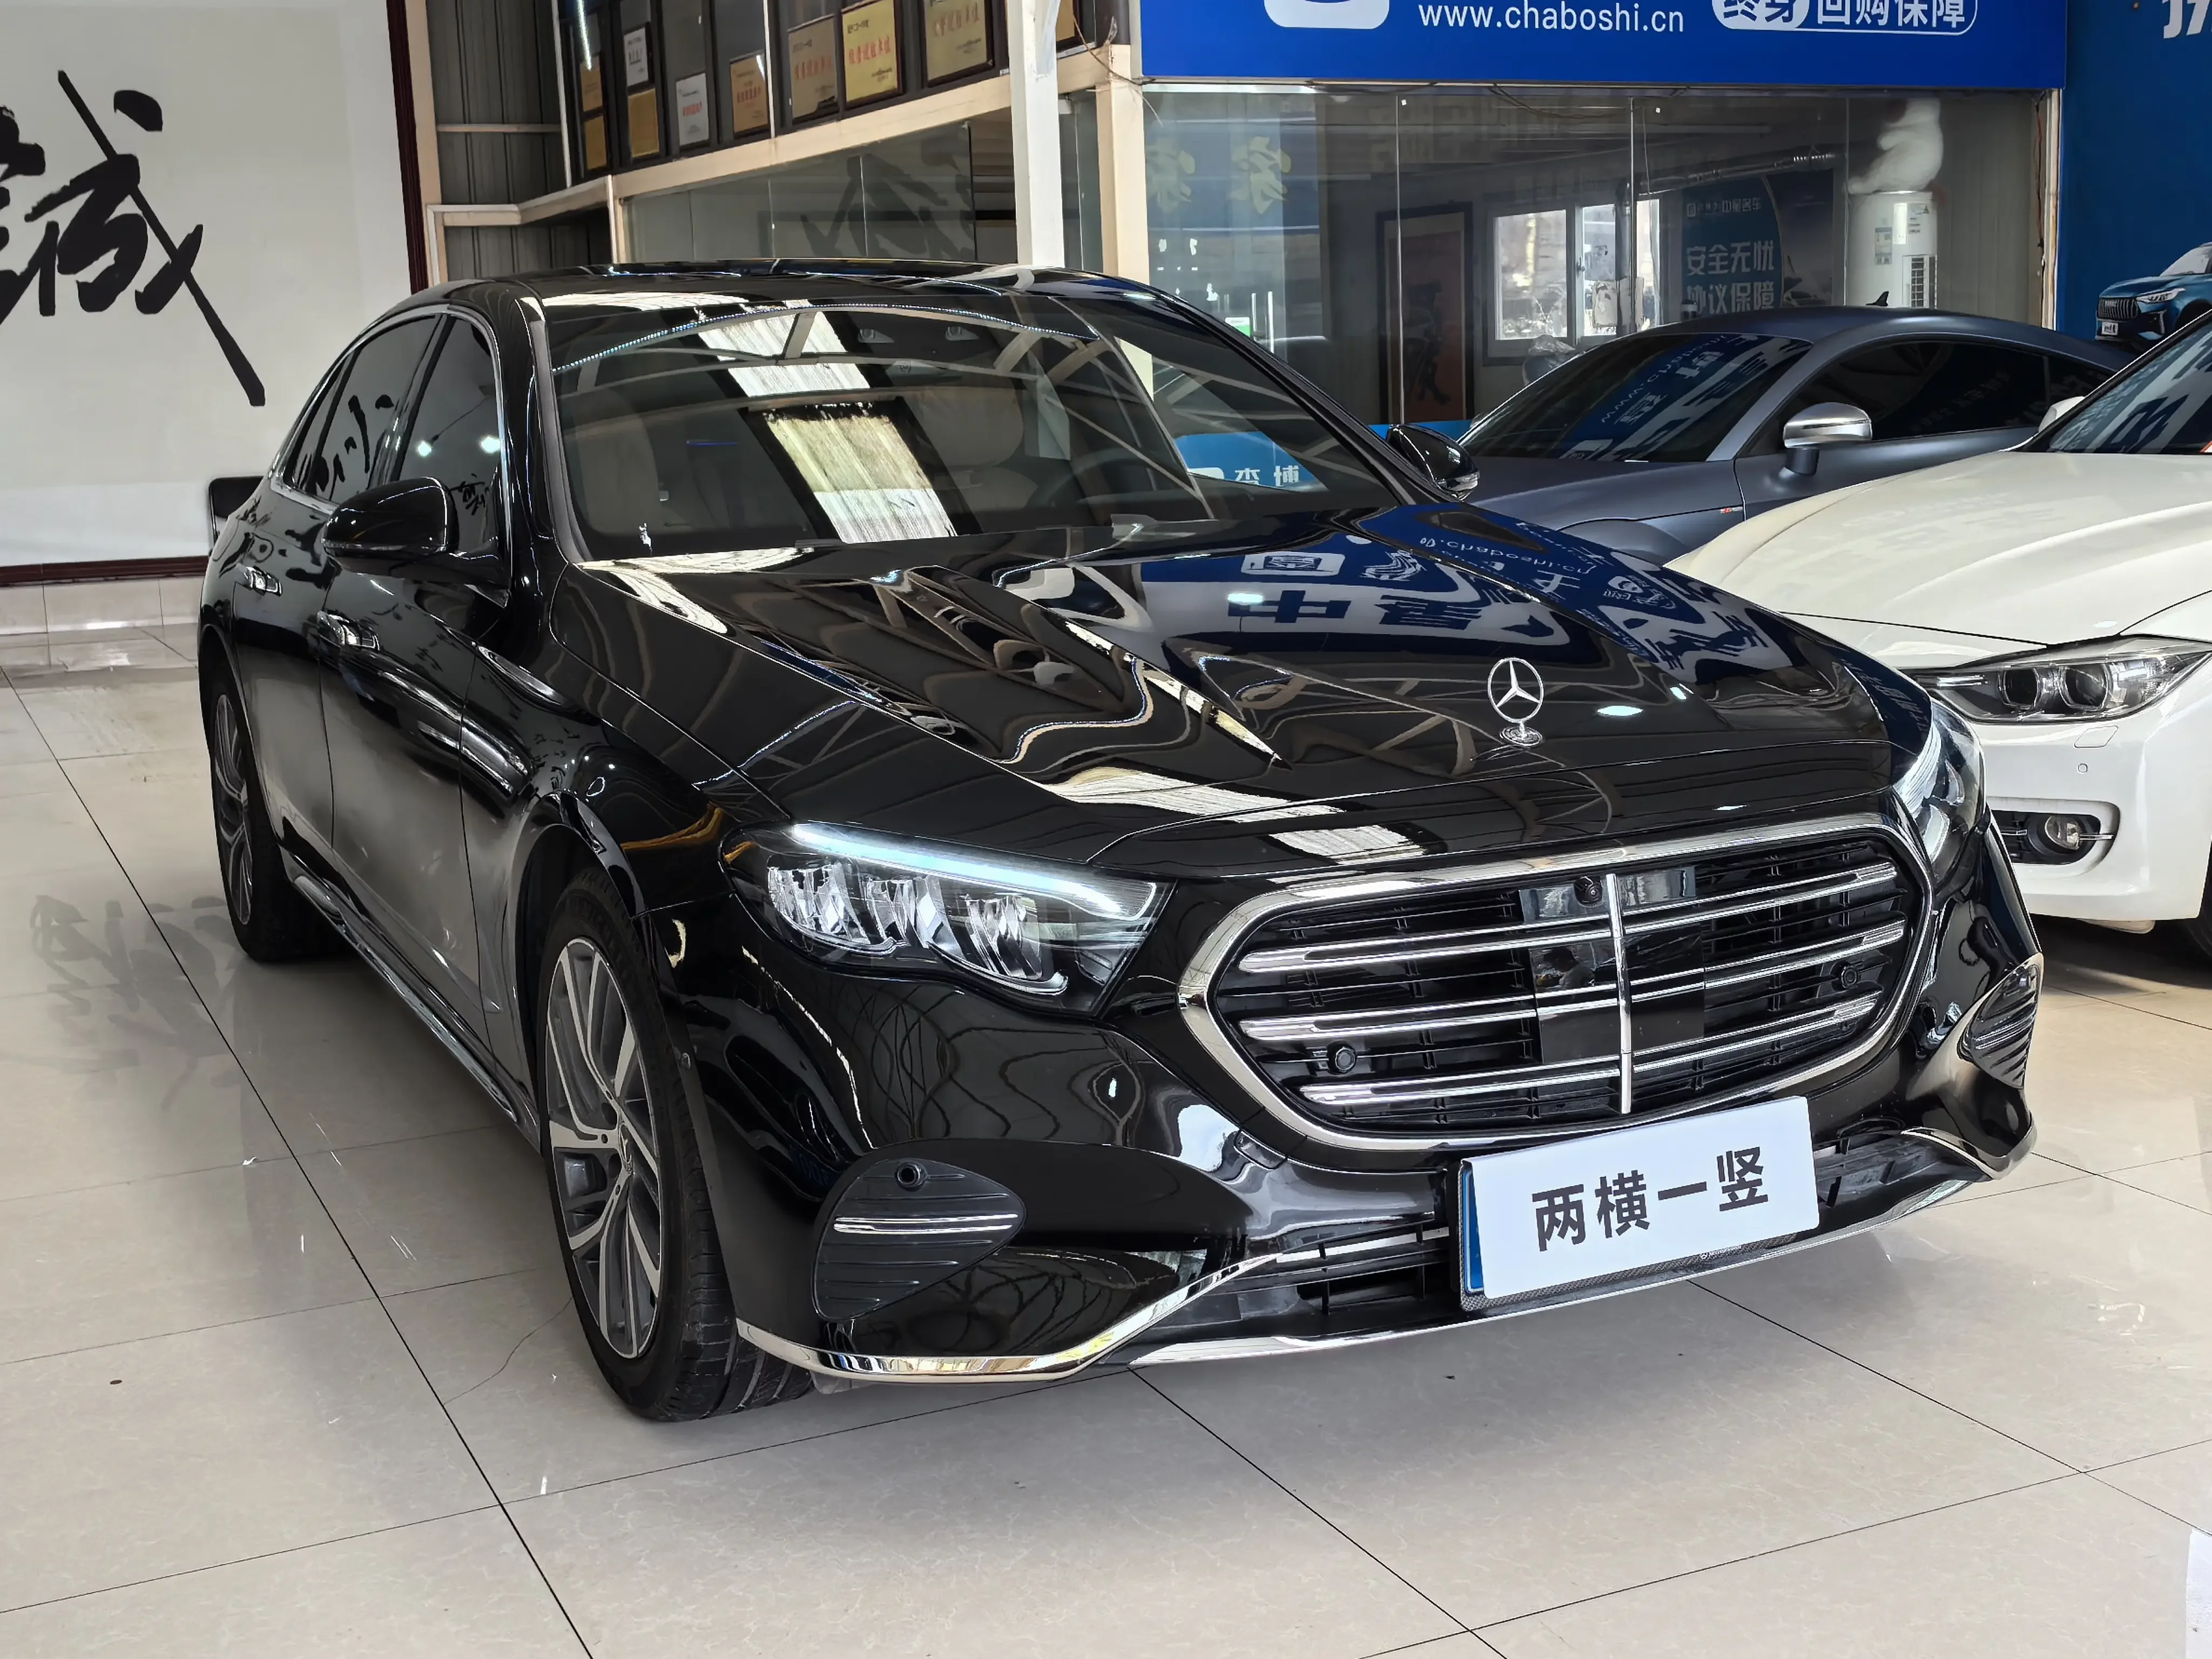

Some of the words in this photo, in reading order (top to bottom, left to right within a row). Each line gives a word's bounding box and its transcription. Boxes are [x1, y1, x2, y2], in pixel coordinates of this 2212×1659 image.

[1418, 0, 1684, 32] www.chaboshi.cn
[1687, 240, 1775, 275] 安全无忧
[1532, 1147, 1769, 1252] 两横一竖
